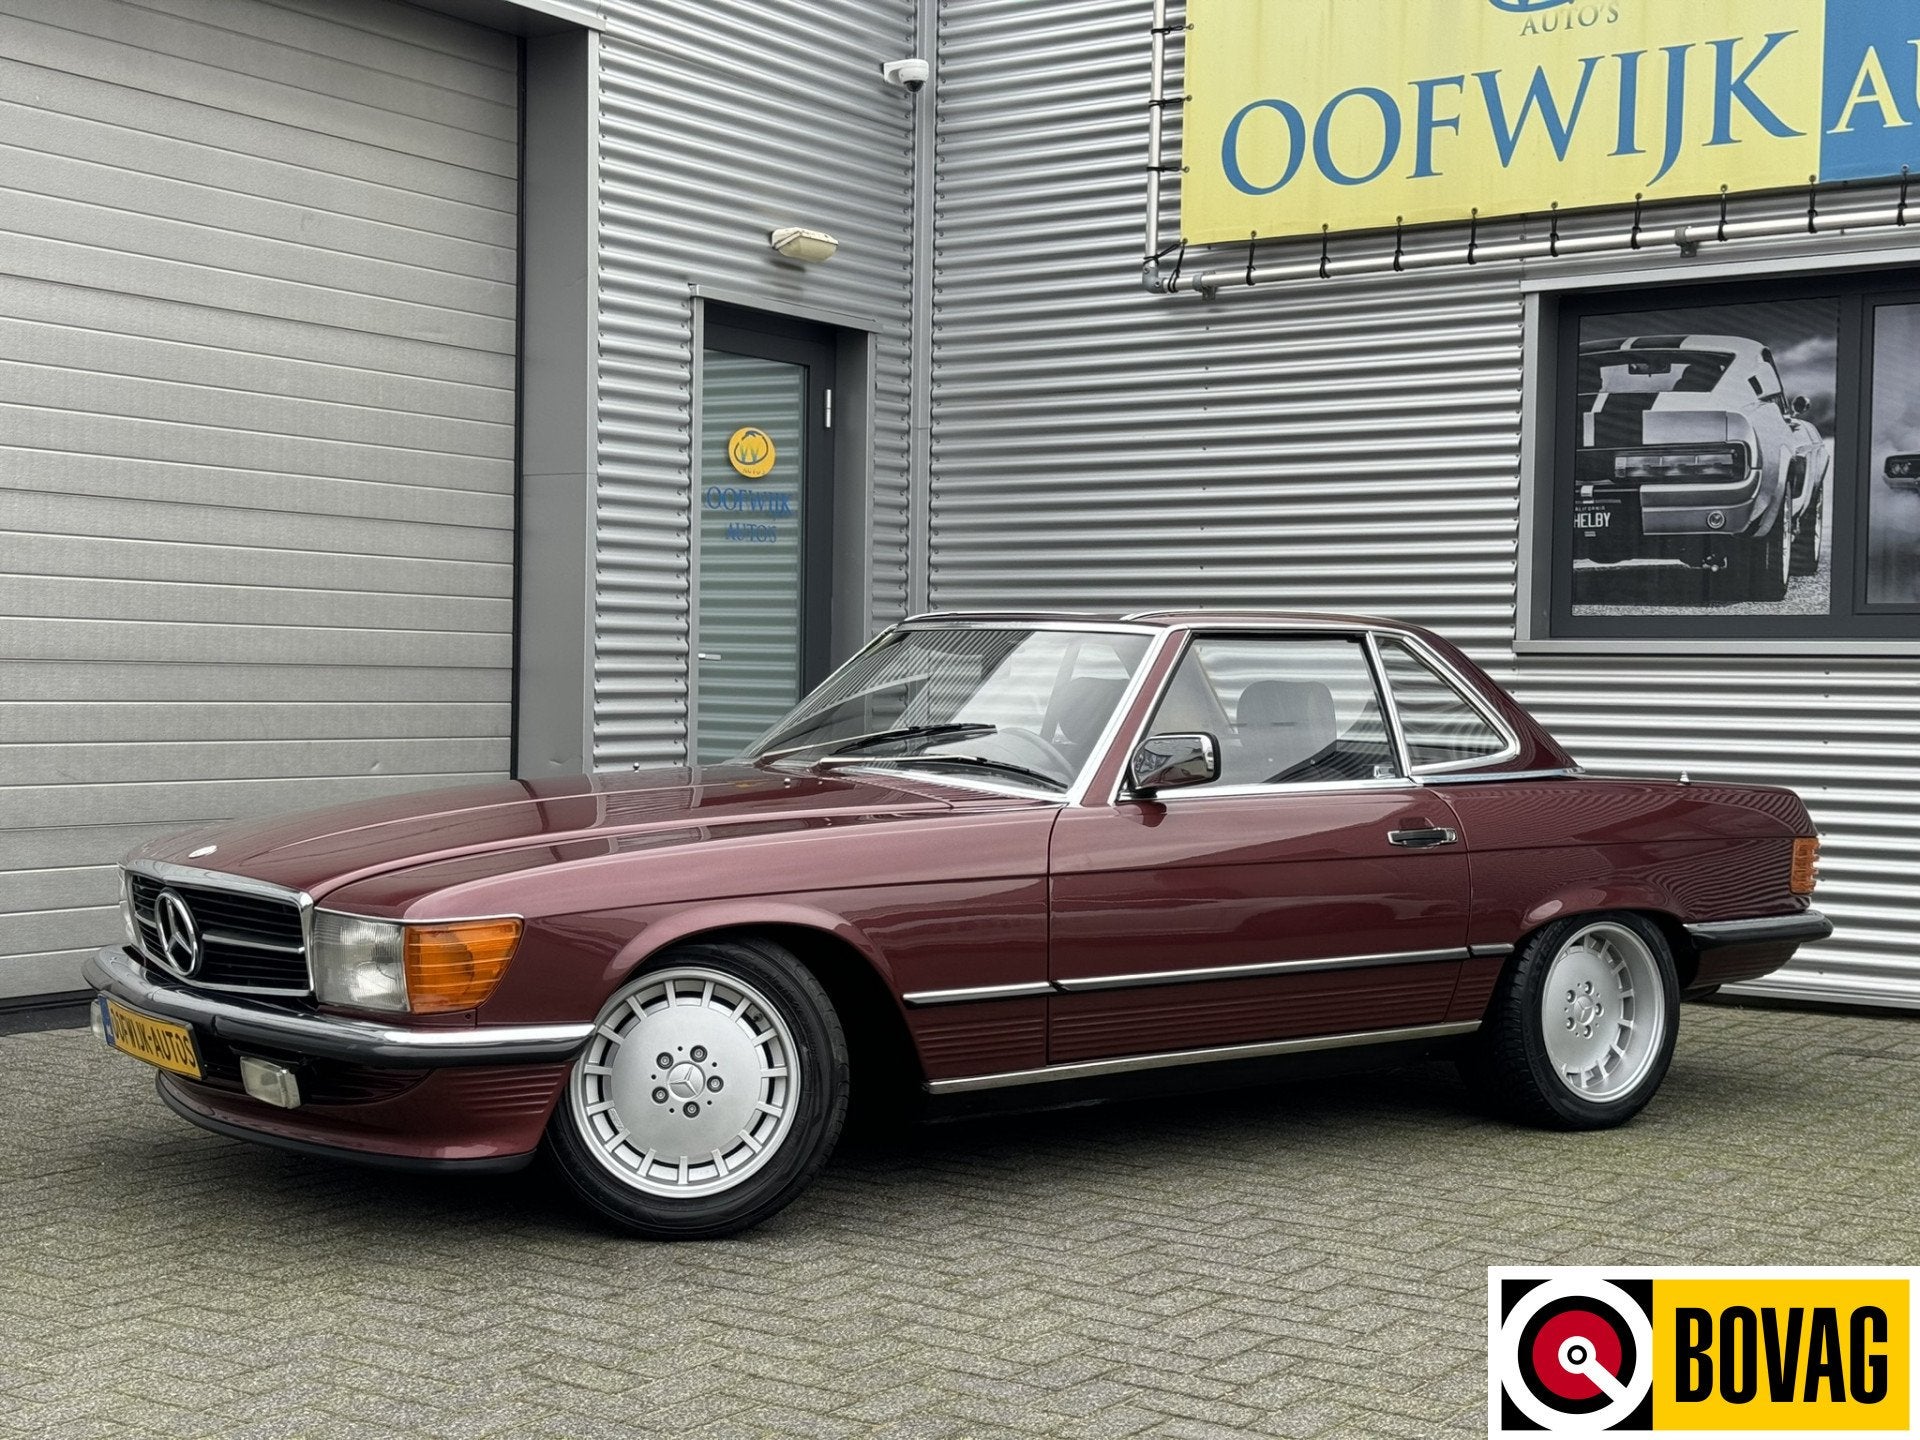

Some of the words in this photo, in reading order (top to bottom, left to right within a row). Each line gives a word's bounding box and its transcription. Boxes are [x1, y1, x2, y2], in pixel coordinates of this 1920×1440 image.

[1519, 2, 1619, 36] AUTO'S
[1221, 30, 1807, 195] OOFWIJK
[705, 486, 793, 520] OOFWIJK
